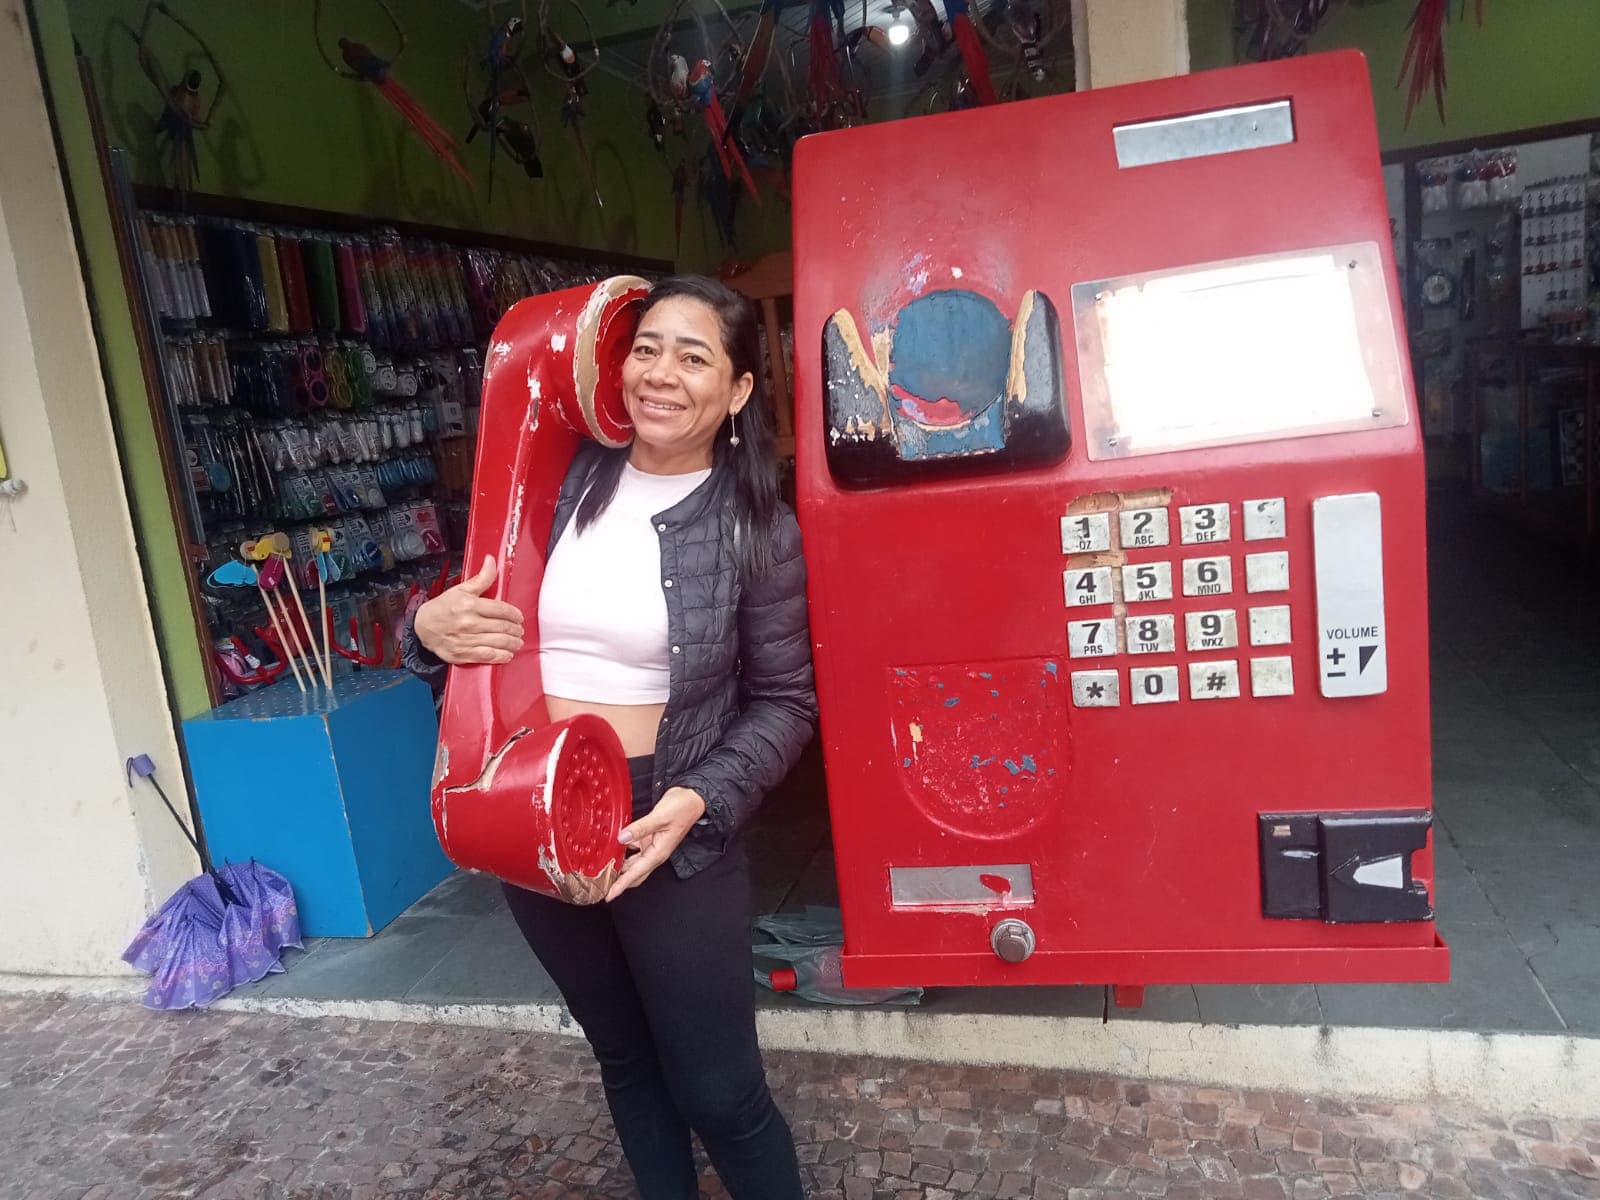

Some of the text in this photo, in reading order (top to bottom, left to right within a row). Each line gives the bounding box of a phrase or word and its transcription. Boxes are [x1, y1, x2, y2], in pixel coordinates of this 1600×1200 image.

[1075, 517, 1090, 539] 1
[1133, 512, 1153, 535] 2
[1195, 507, 1215, 530] 3
[1134, 534, 1154, 545] ABC
[1196, 530, 1217, 542] DEF
[1136, 566, 1157, 589] 5
[1197, 561, 1218, 583] 6
[1076, 572, 1097, 593] 4
[1197, 583, 1221, 594] MNO
[1079, 594, 1096, 605] GHI
[1138, 589, 1157, 601] JKL
[1081, 622, 1101, 645] 7
[1138, 619, 1159, 642] 8
[1200, 614, 1221, 636] 9
[1326, 626, 1379, 640] VOLUME
[1083, 644, 1103, 655] PRS
[1139, 642, 1159, 652] TUV
[1201, 636, 1225, 648] WXZ
[1144, 673, 1163, 696] 0
[1206, 672, 1227, 691] #
